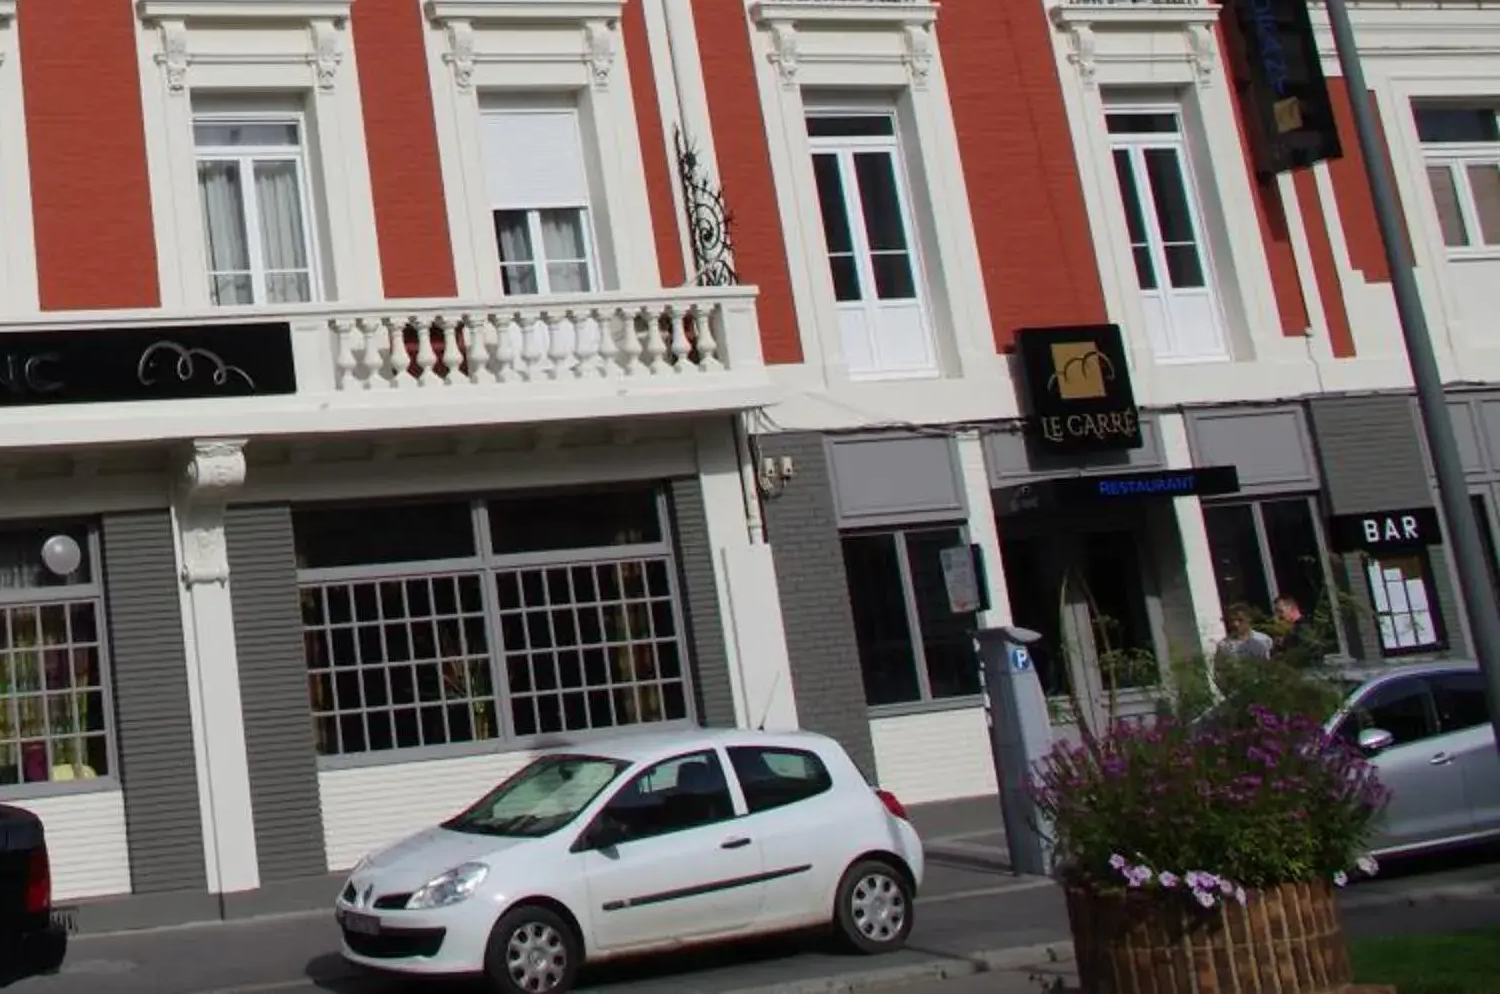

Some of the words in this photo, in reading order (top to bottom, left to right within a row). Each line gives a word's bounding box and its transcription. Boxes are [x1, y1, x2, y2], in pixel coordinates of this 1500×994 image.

[1041, 415, 1064, 442] LE
[1067, 407, 1137, 439] CARRÉ
[1099, 475, 1195, 495] RESTAURANT
[1362, 515, 1419, 543] BAR
[1015, 649, 1027, 668] P
